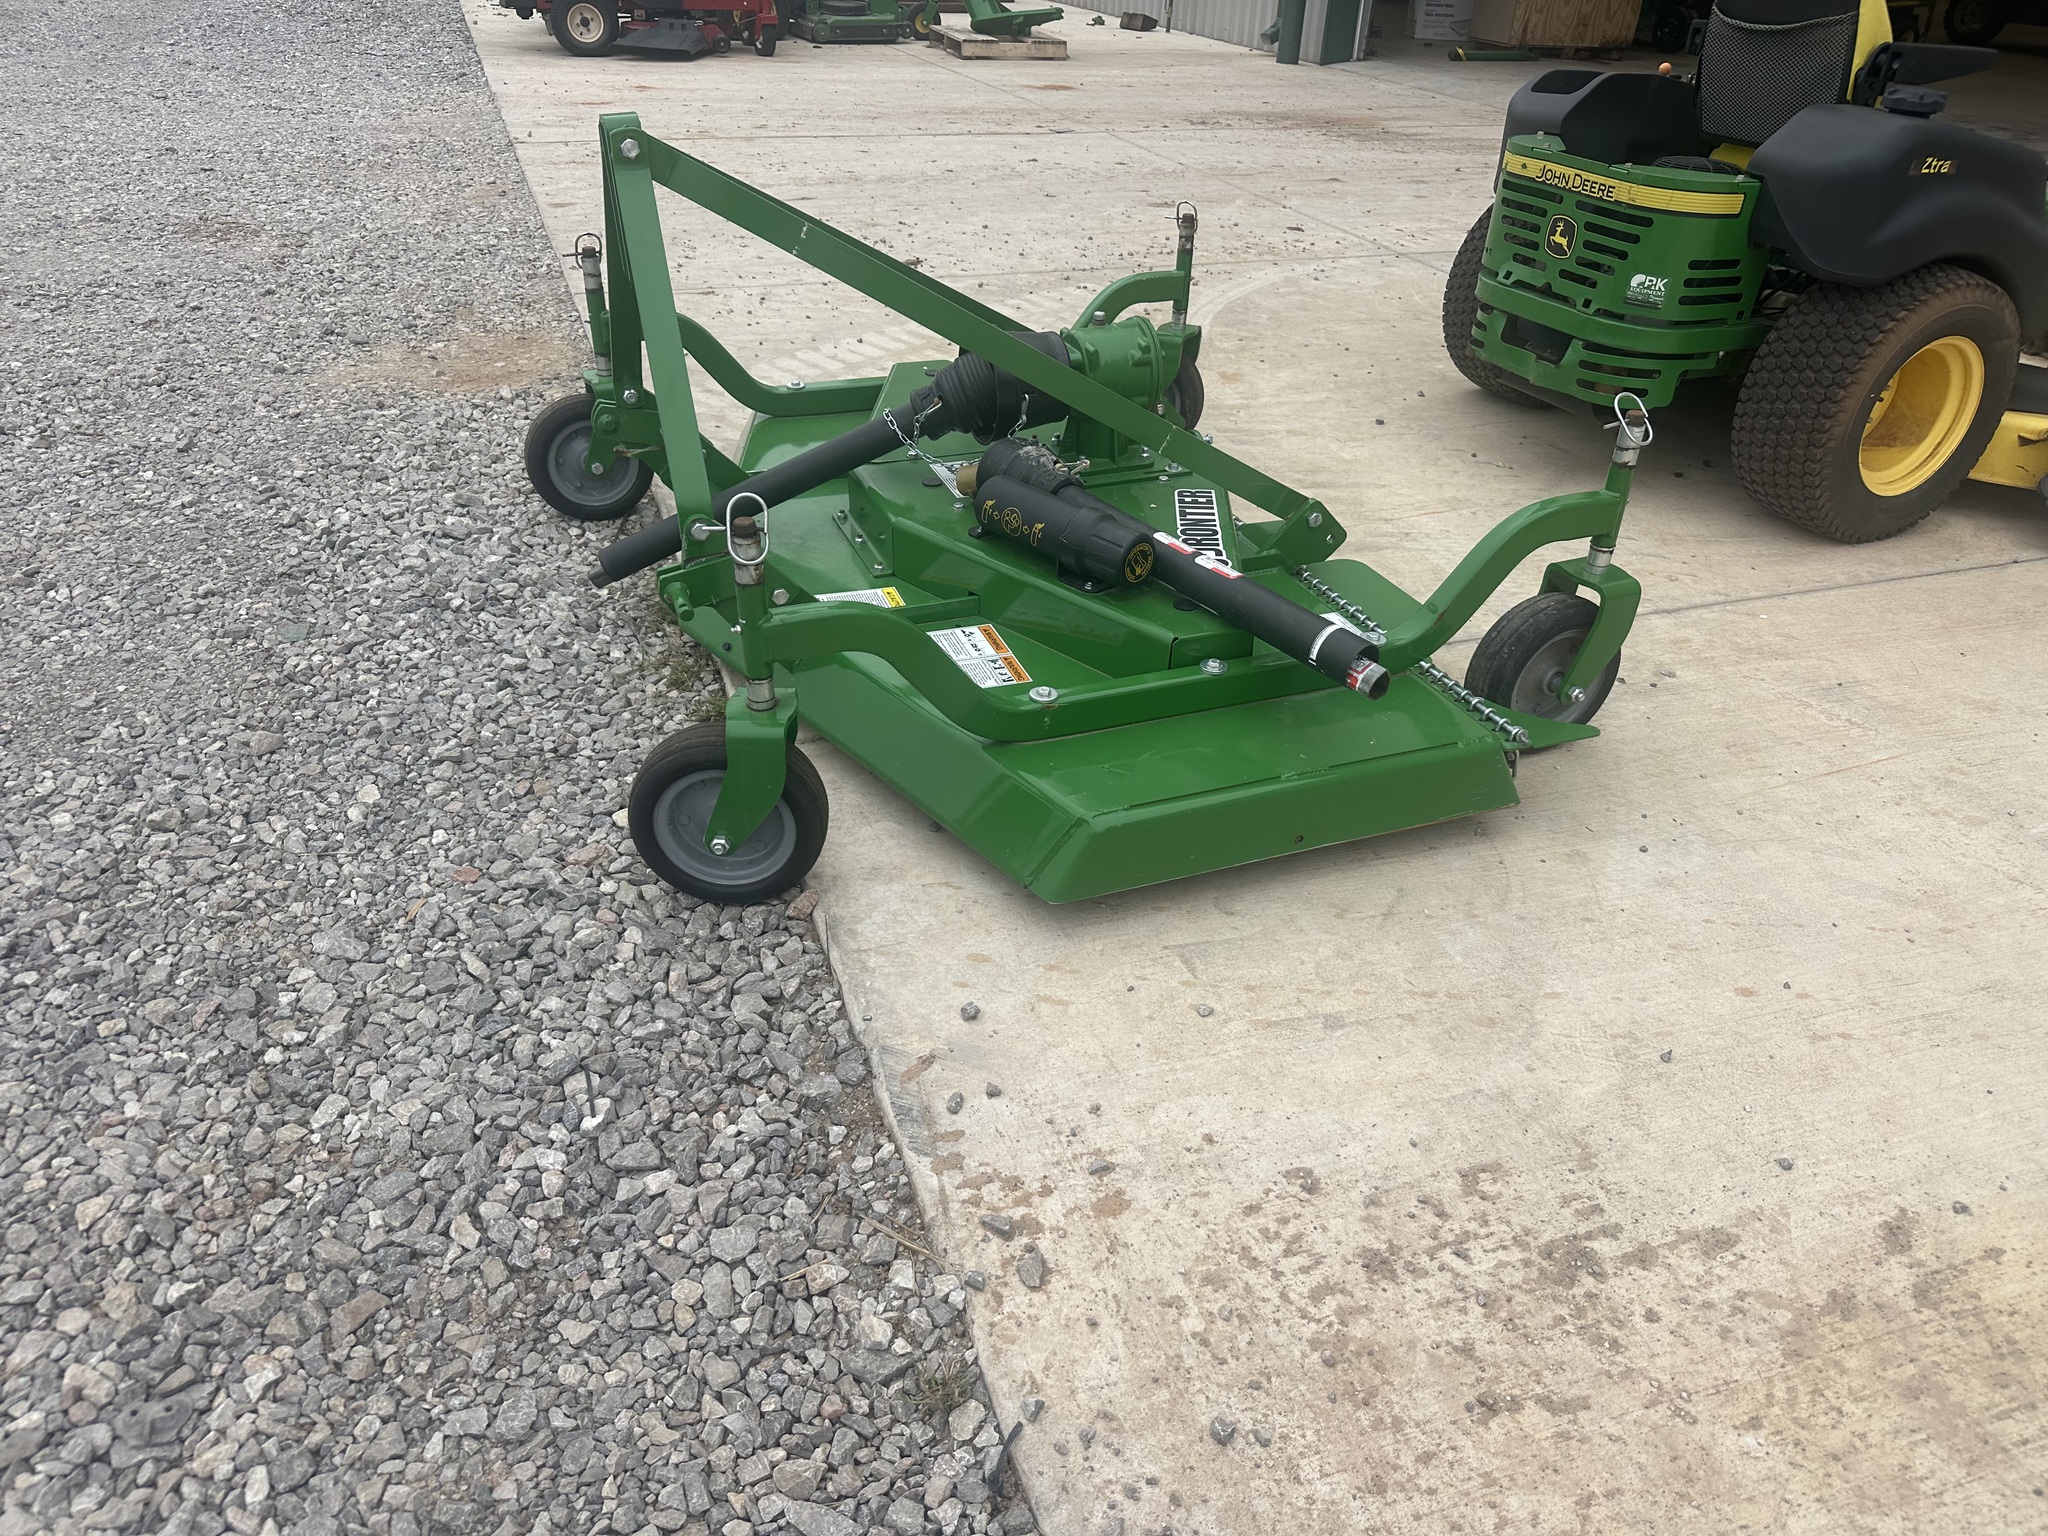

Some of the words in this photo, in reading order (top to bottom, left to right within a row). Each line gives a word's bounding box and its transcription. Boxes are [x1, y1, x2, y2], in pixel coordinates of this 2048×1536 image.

[1536, 165, 1571, 187] JOHN
[1572, 173, 1616, 199] DEERE
[1629, 287, 1666, 297] EQUIPMENT
[984, 630, 1004, 651] WARNING
[1006, 658, 1026, 682] WARNING
